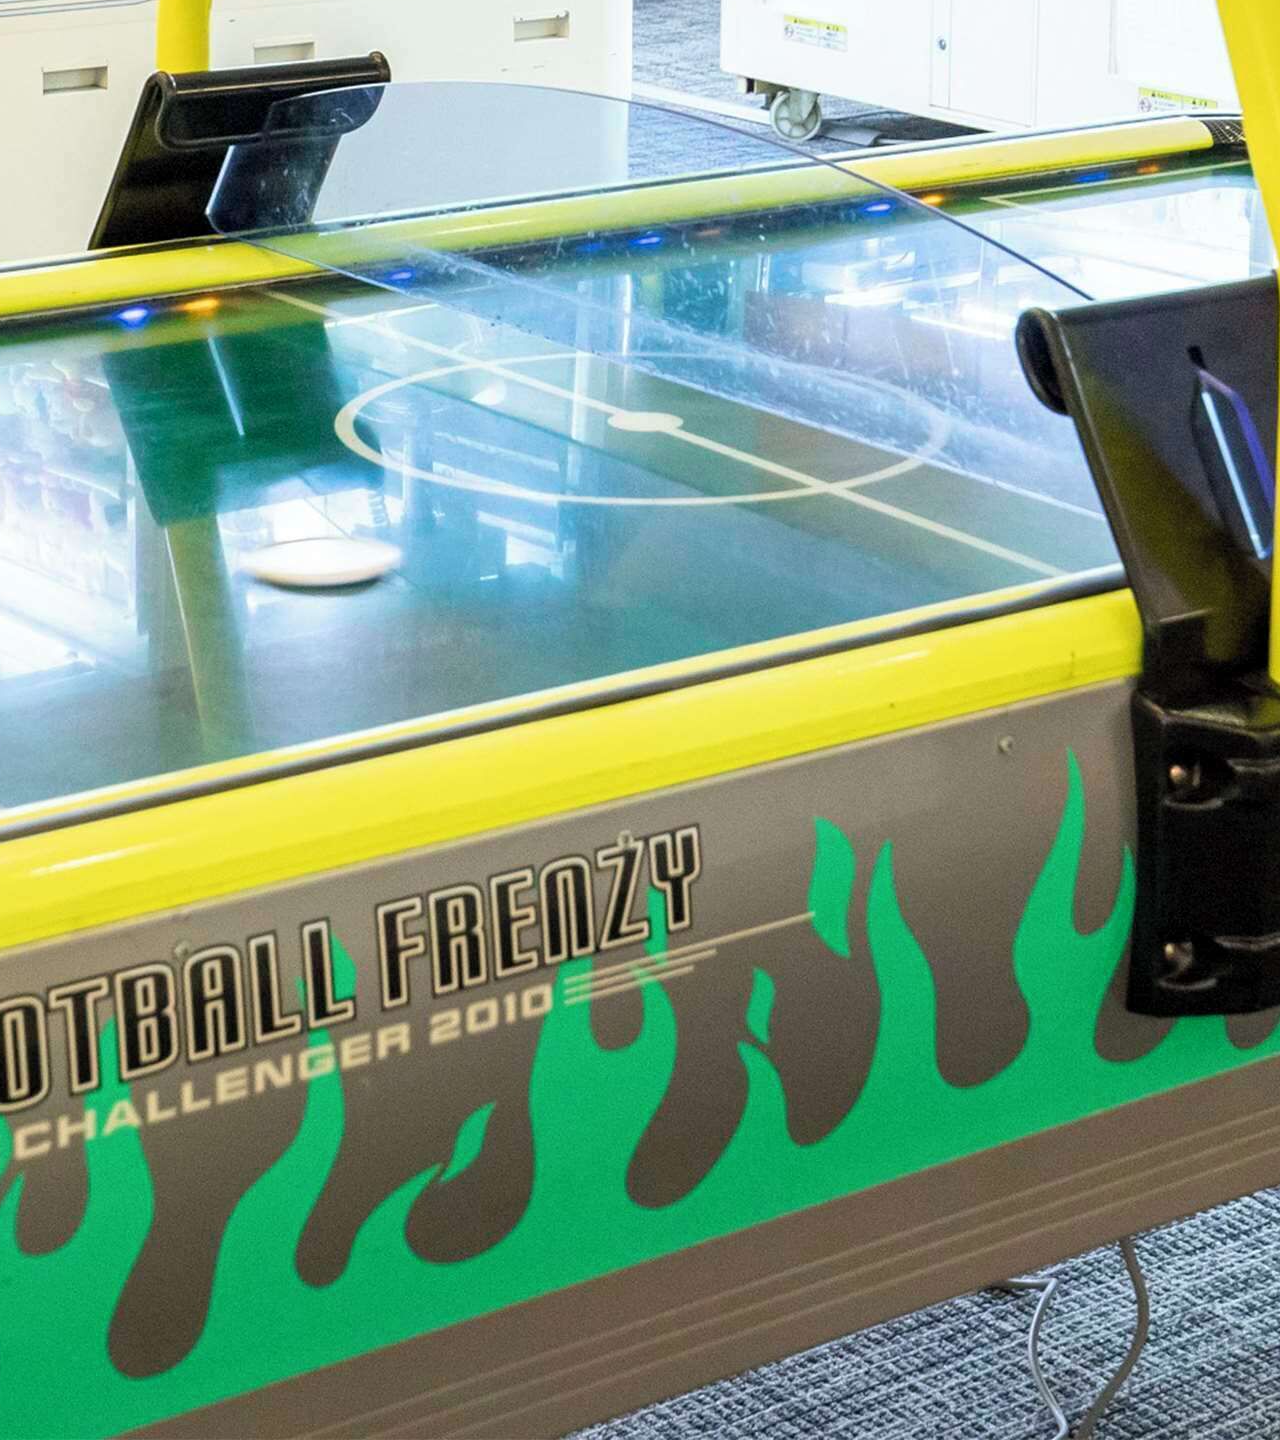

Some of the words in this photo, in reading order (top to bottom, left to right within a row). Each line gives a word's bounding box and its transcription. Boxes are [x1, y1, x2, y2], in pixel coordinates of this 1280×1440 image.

[374, 823, 703, 1012] FRENZY
[12, 1021, 412, 1159] CHALLENGER
[428, 983, 554, 1046] 2010
